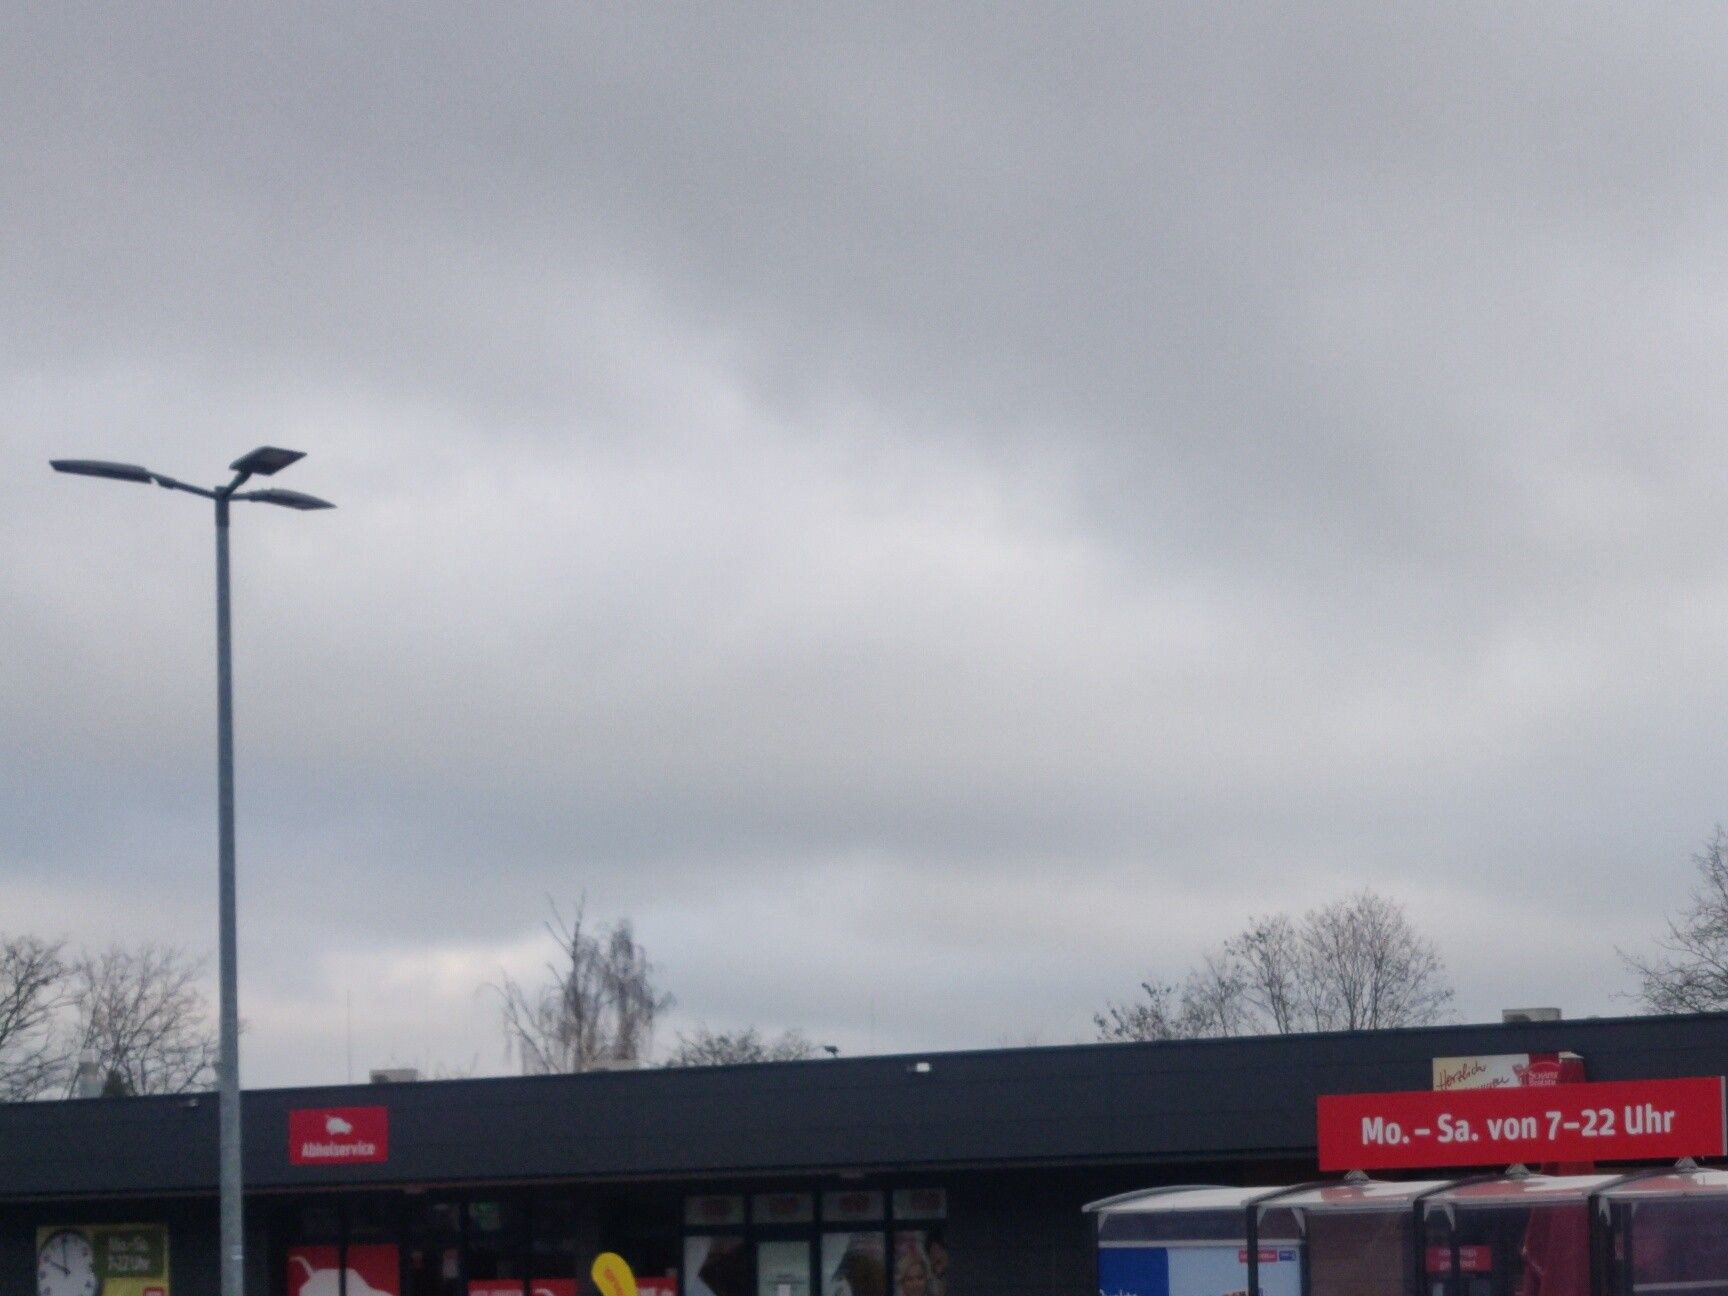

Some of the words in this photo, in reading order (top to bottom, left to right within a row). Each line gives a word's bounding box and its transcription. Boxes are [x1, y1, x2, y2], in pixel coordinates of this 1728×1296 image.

[1361, 1115, 1410, 1145] Mo.
[1437, 1113, 1479, 1143] Sa.
[1487, 1115, 1538, 1141] von
[1624, 1102, 1676, 1135] Uhr
